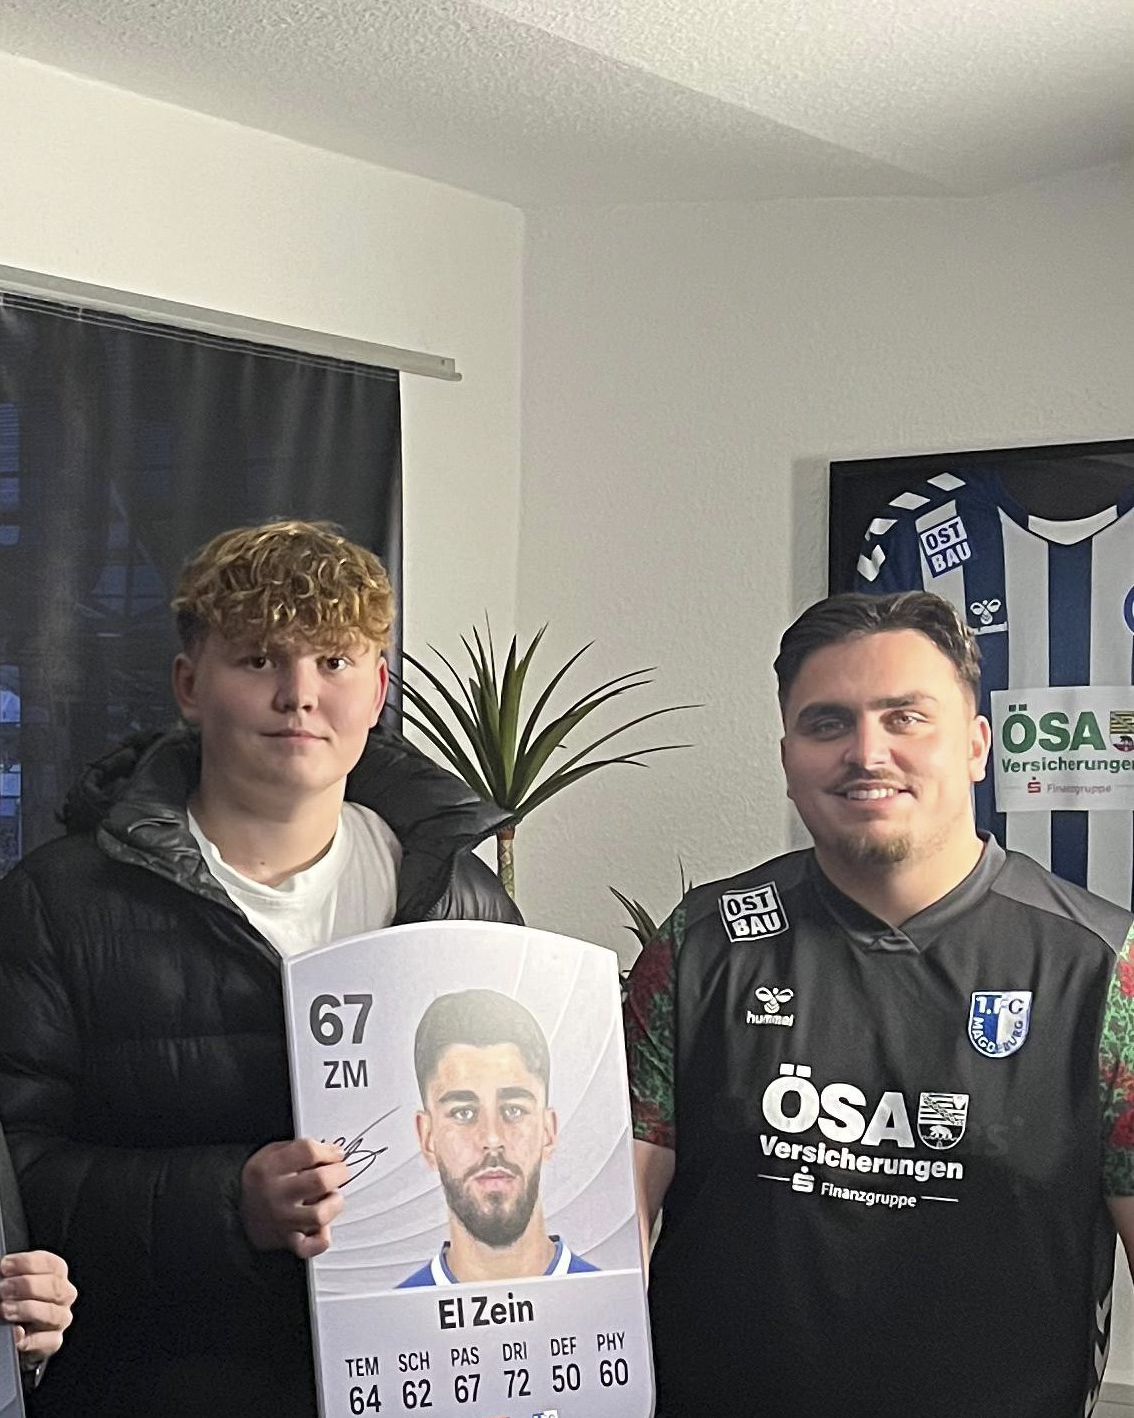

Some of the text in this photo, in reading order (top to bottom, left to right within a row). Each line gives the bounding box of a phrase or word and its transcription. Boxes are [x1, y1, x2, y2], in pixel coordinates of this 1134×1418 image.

[926, 521, 962, 551] OST
[931, 541, 972, 573] BAU
[1002, 703, 1107, 754] ÖSA
[727, 891, 769, 916] OST
[732, 911, 781, 937] BAU
[309, 993, 373, 1046] 67
[746, 1010, 794, 1027] hummel
[323, 1060, 368, 1089] ZM
[762, 1063, 916, 1149] ÖSA
[759, 1134, 964, 1182] Versicherungen
[821, 1182, 917, 1209] Finanzgruppe
[471, 1292, 534, 1327] Zein
[345, 1331, 625, 1377] TEM SCH PAS DRI DEF PHY
[349, 1358, 629, 1415] 64 62 67 72 50 60
